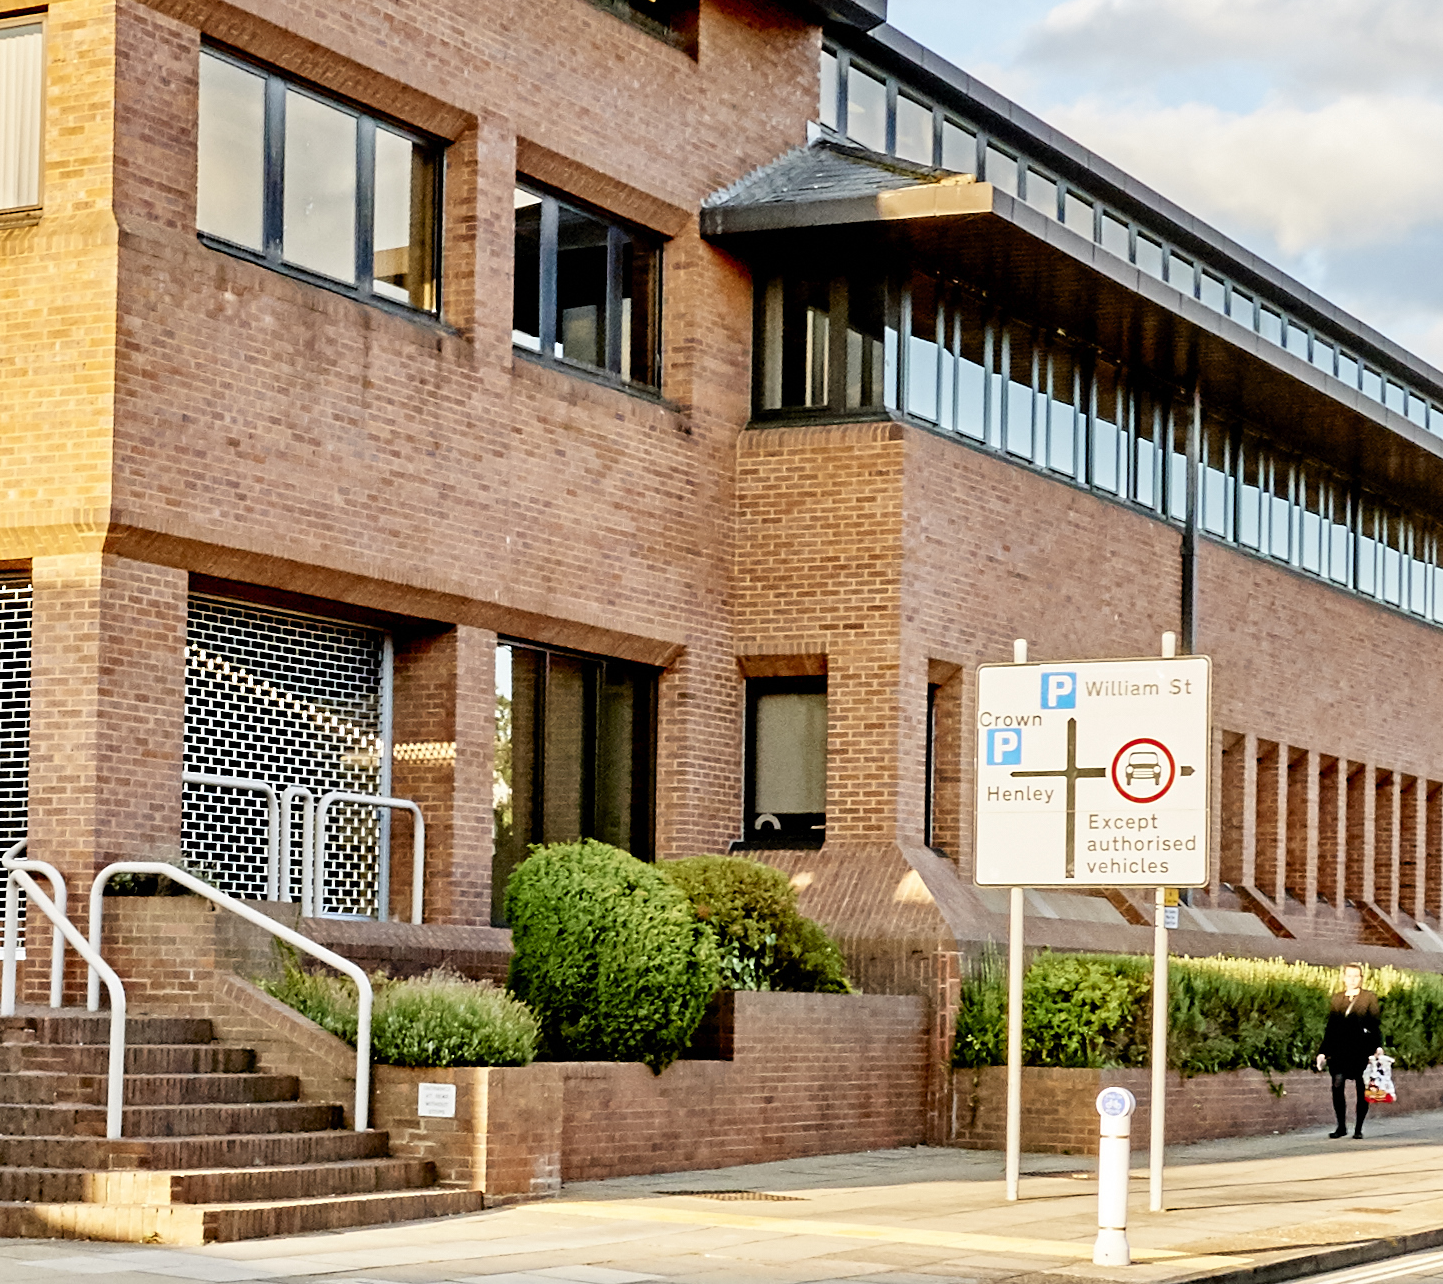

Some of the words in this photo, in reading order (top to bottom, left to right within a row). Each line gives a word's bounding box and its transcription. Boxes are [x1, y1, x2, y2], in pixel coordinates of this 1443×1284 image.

[1048, 675, 1073, 707] P
[1086, 680, 1159, 696] William
[1168, 679, 1192, 695] St
[979, 712, 1042, 727] Crown
[993, 731, 1018, 763] P
[987, 786, 1054, 803] Henley
[1088, 814, 1158, 832] Except
[1087, 836, 1196, 851] authorised
[1087, 858, 1169, 873] vehicles
